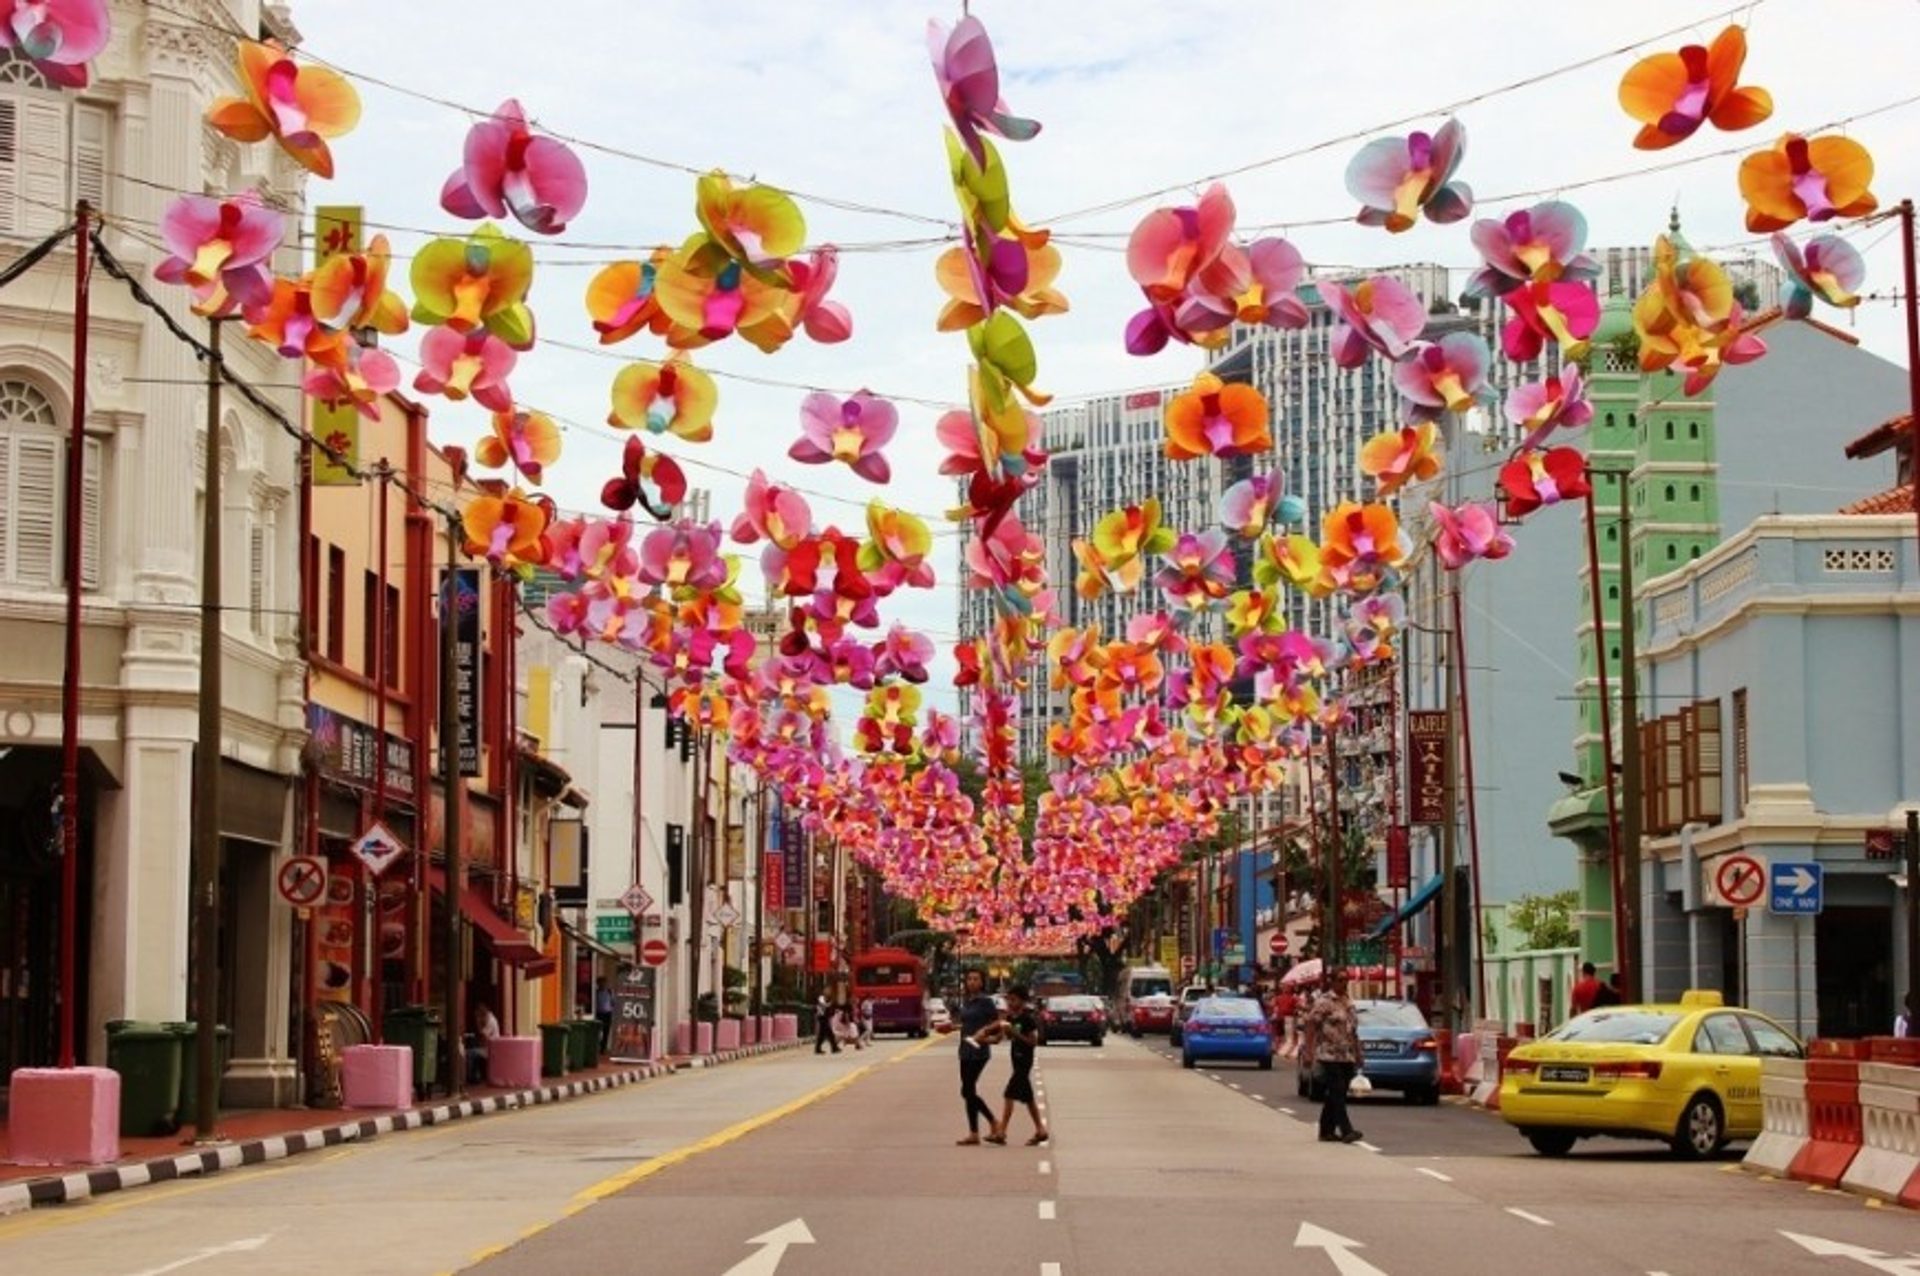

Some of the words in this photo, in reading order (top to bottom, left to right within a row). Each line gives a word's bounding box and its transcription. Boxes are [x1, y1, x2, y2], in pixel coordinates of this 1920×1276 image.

[1421, 742, 1443, 806] TAILOR
[1775, 896, 1794, 909] ONE
[1798, 896, 1818, 909] WAY
